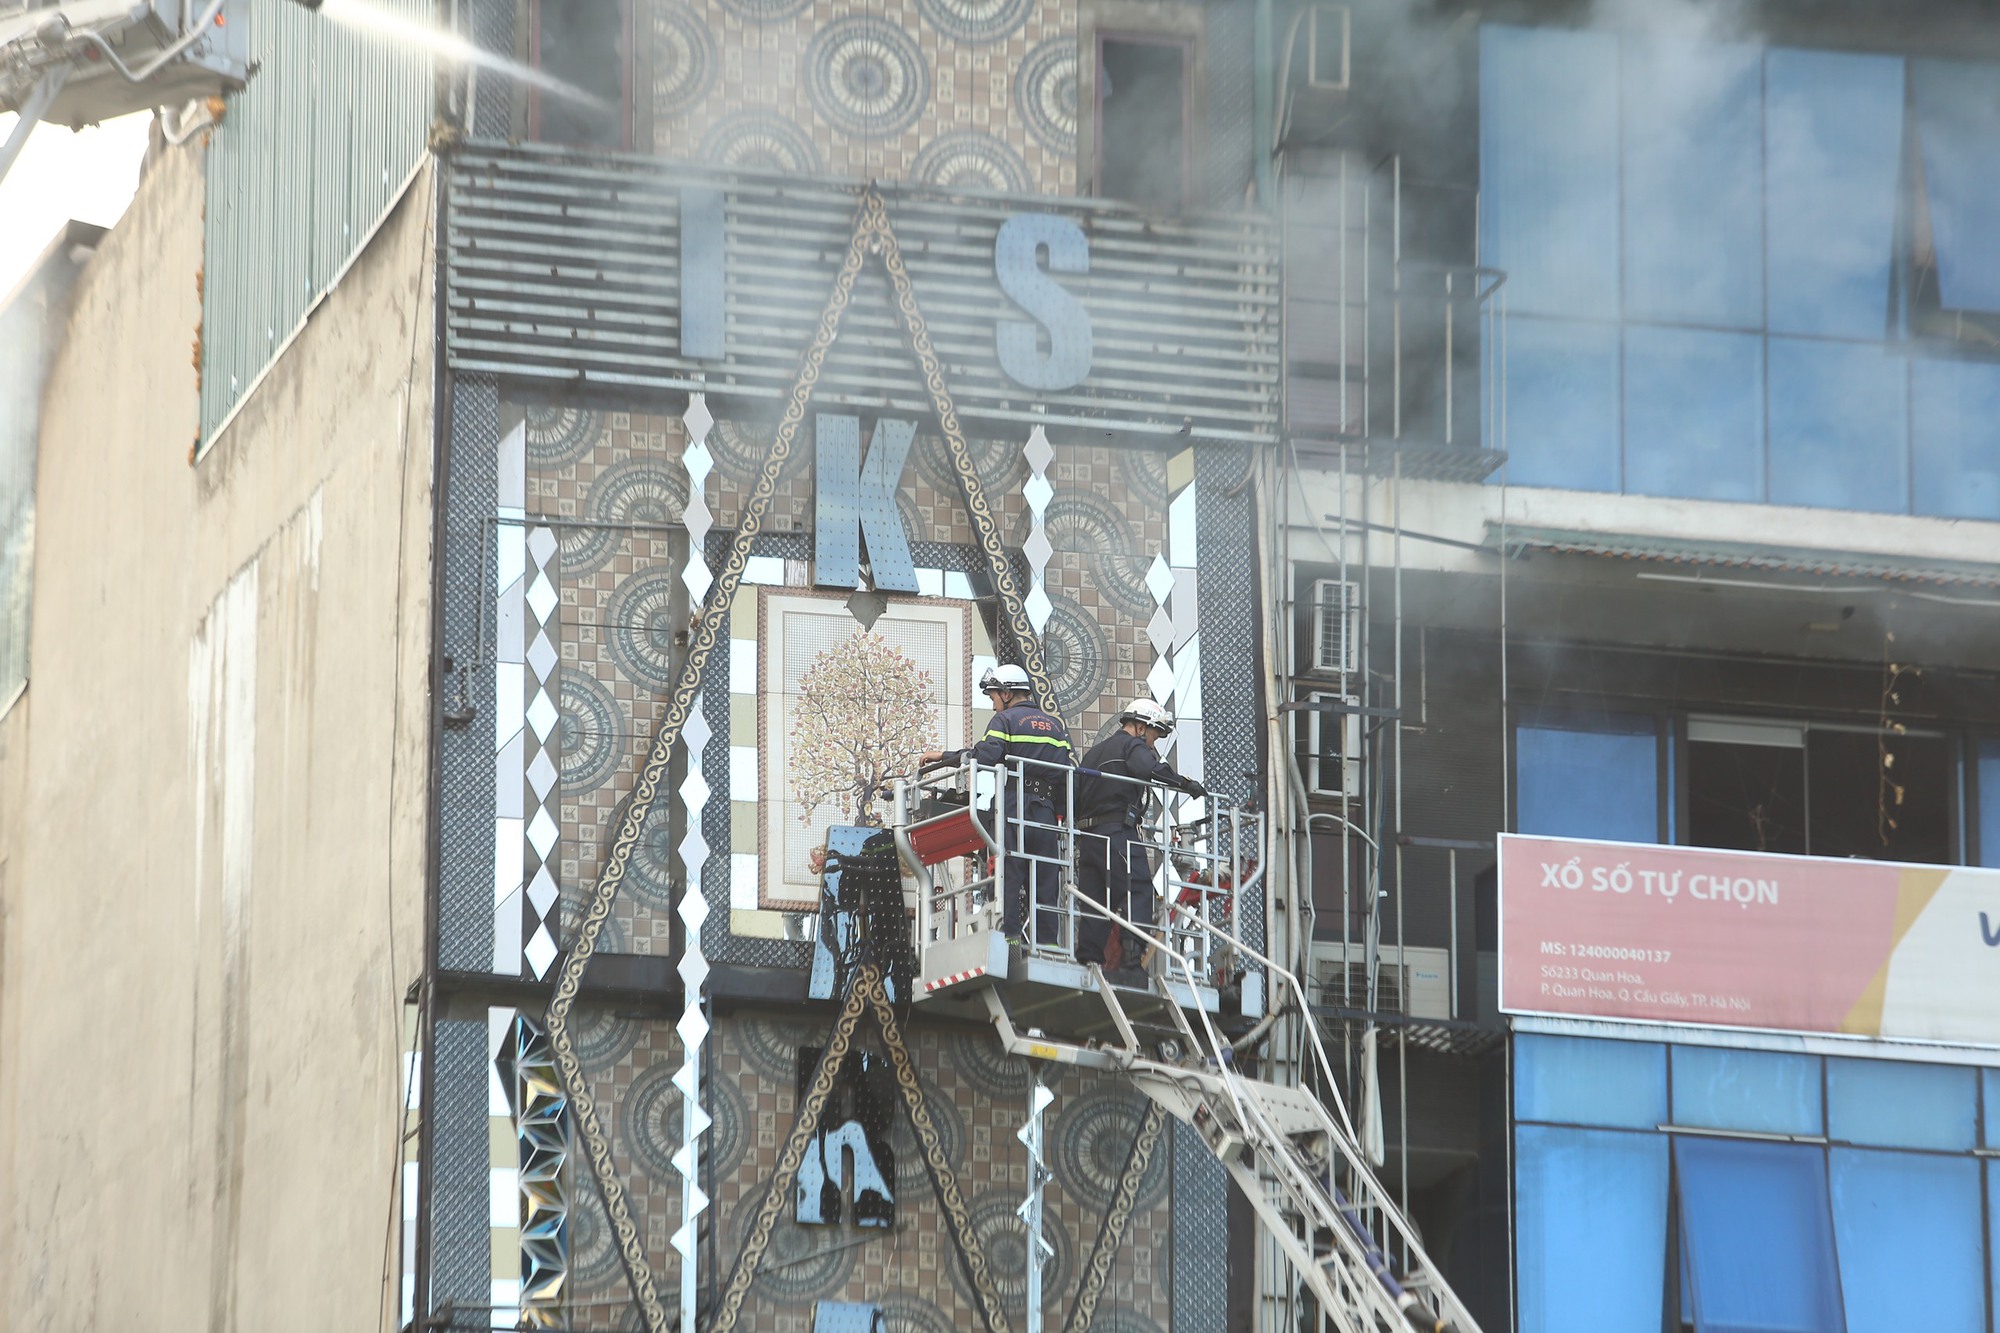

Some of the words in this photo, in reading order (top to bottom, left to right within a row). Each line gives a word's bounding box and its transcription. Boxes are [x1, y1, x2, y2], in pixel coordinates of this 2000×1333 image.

[1540, 856, 1584, 890] XỔ
[1591, 861, 1634, 894] SỐ
[1638, 869, 1683, 904] TỰ
[1689, 875, 1779, 910] CHỌN
[1540, 941, 1566, 956] MS:
[1569, 943, 1671, 963] 124000040137
[1581, 967, 1614, 982] Quan
[1552, 982, 1586, 998] Quan
